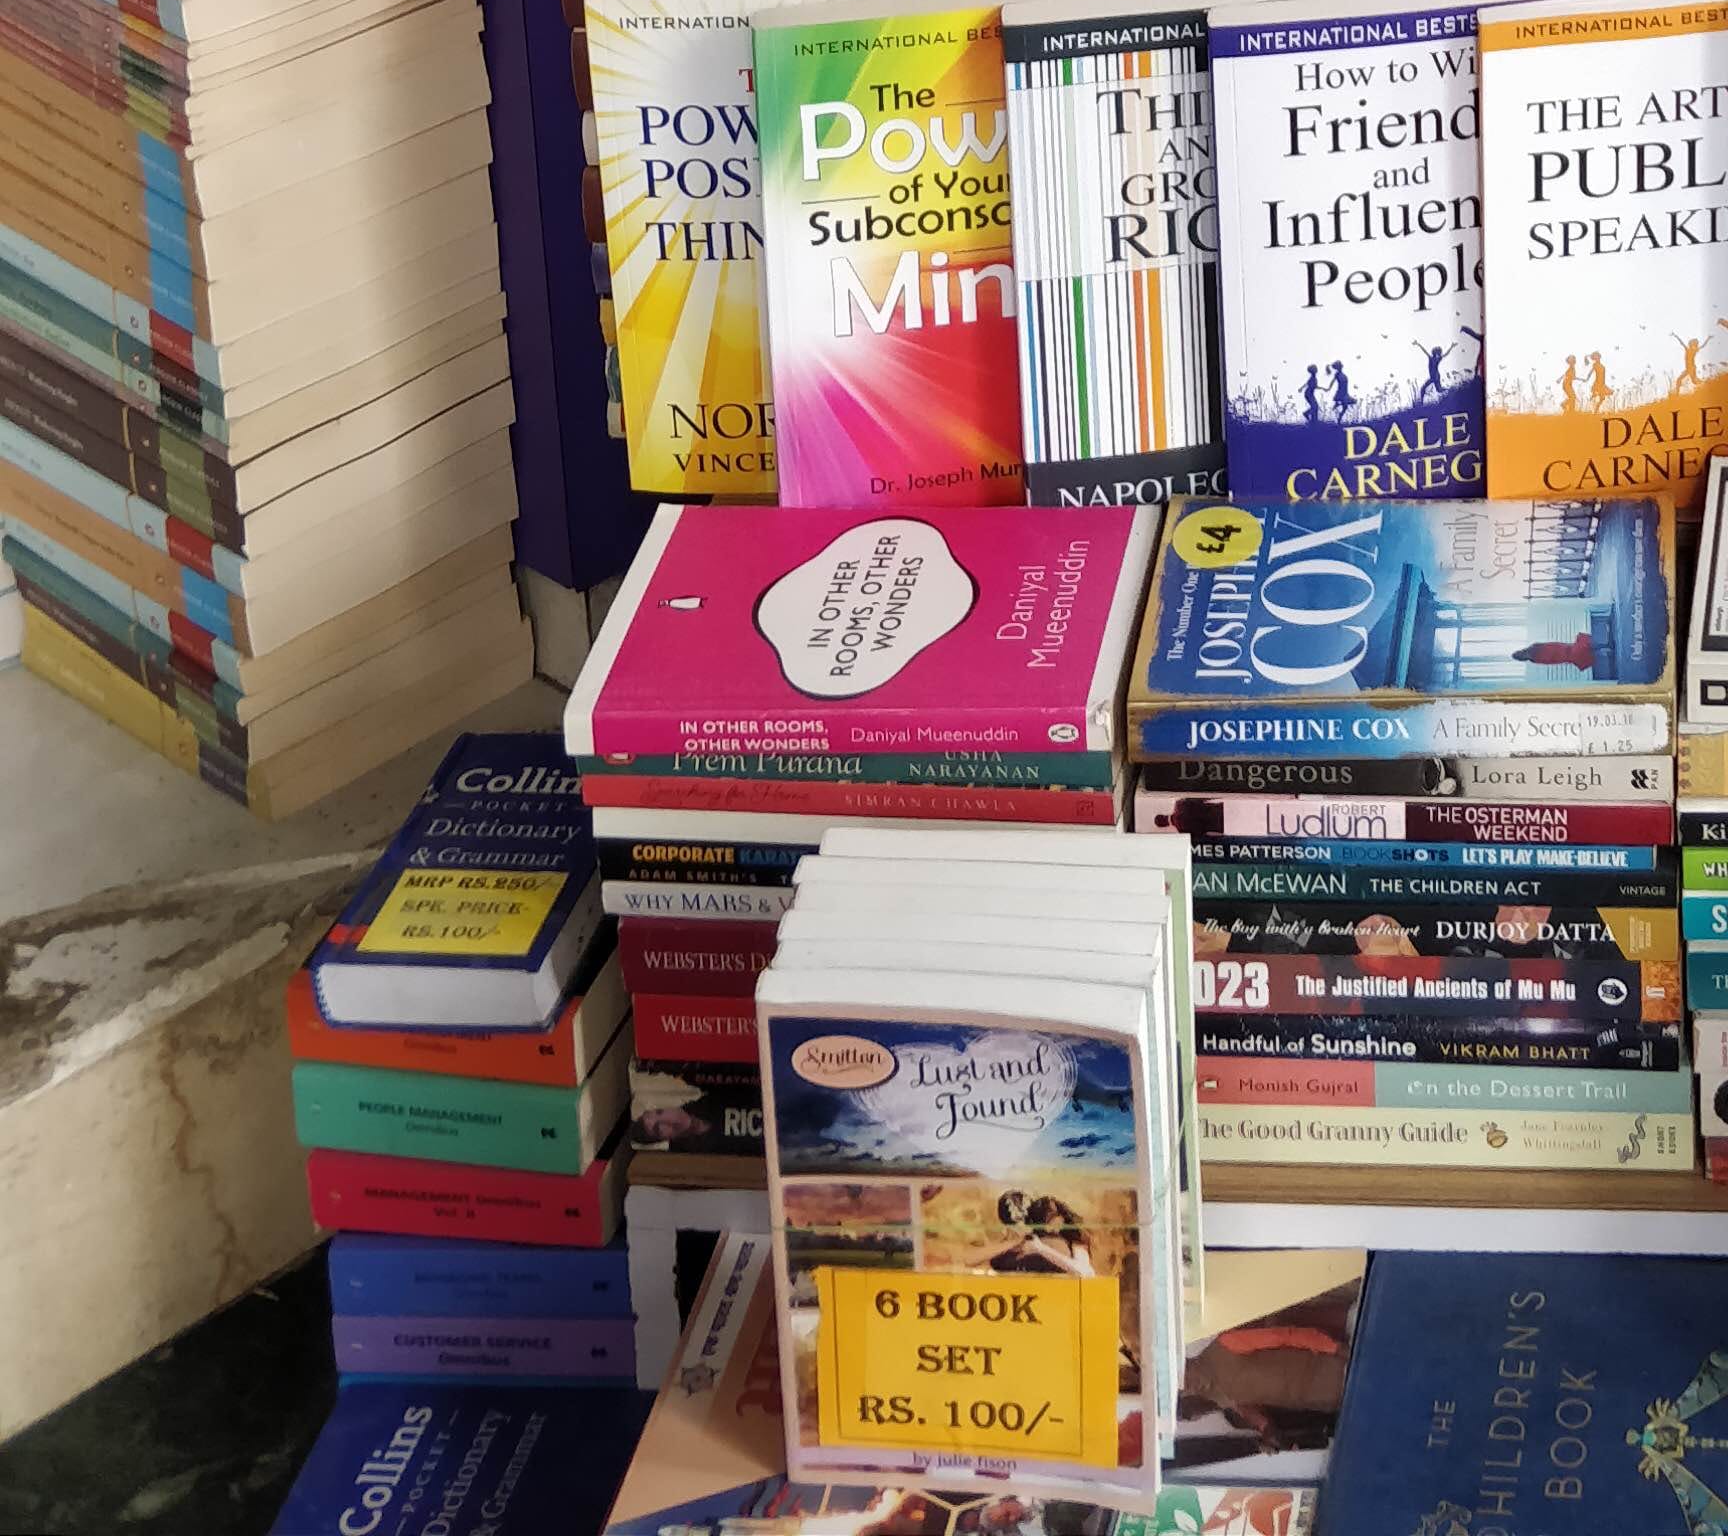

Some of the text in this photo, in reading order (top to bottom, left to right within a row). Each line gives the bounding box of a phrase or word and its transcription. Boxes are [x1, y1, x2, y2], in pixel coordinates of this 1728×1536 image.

[1527, 95, 1624, 135] THE
[1187, 717, 1411, 750] JOSEPHINE COX
[404, 875, 454, 891] MRP
[876, 1291, 1042, 1325] 6 BOOK
[916, 1345, 1001, 1377] SET
[858, 1396, 1065, 1435] RS. 100/-
